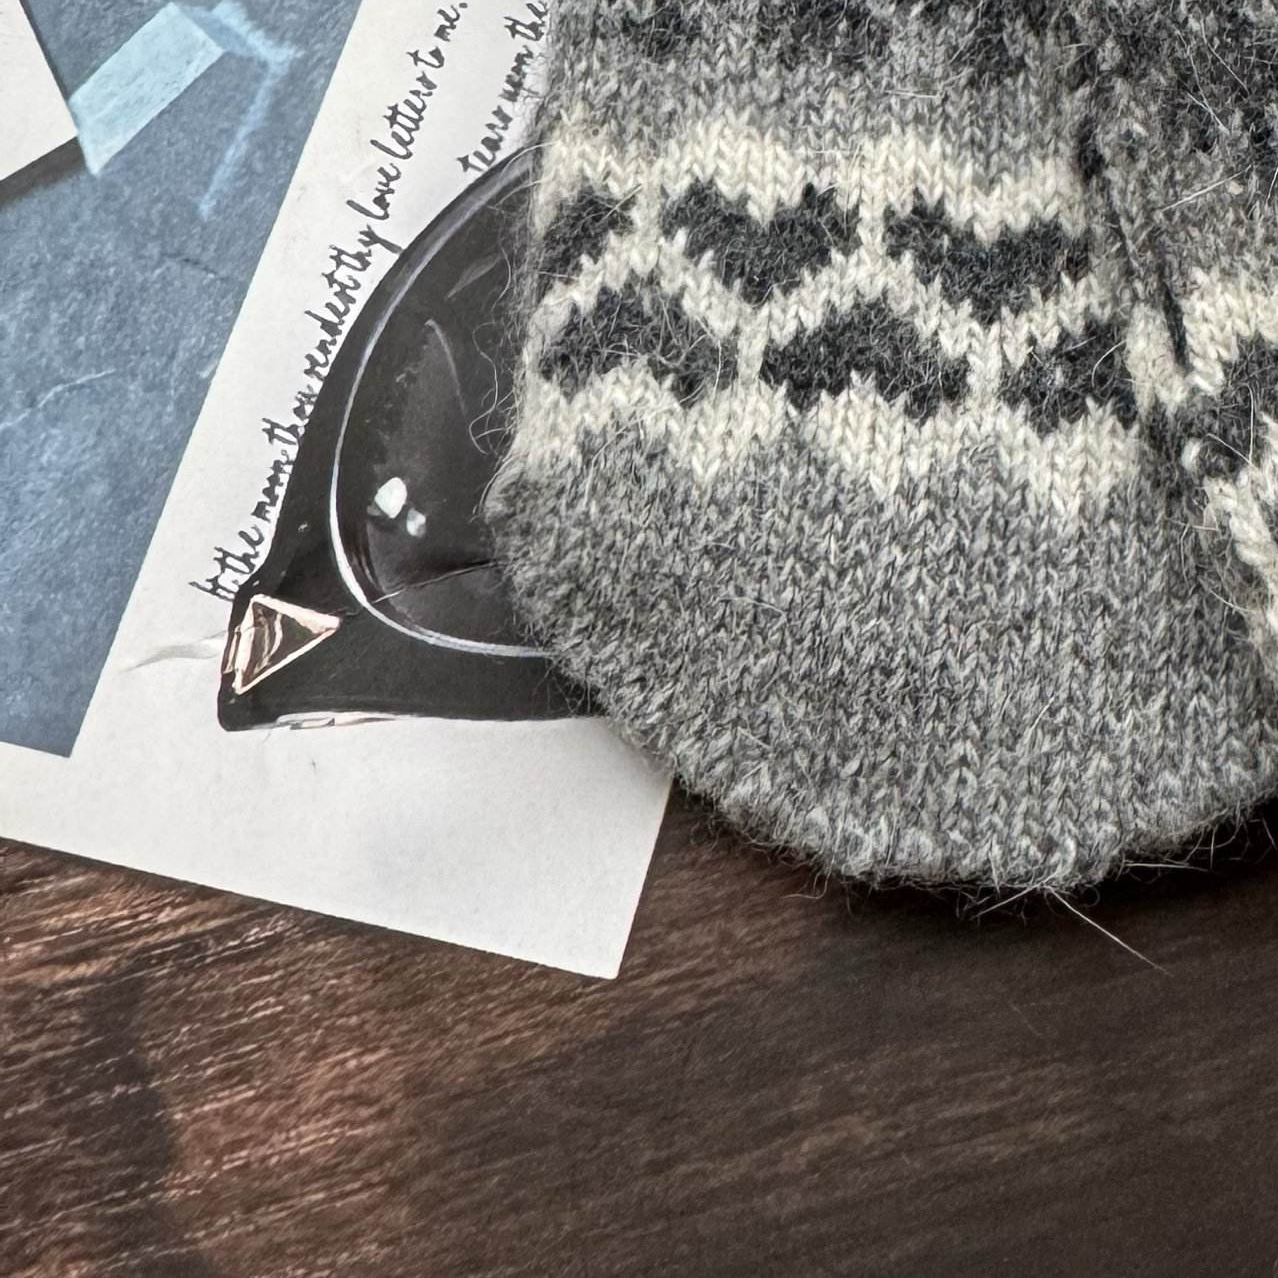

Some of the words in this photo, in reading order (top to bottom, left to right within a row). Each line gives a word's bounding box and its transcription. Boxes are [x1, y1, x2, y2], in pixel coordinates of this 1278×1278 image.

[433, 1, 469, 43] me.
[405, 46, 446, 69] to
[456, 104, 514, 173] tears
[503, 0, 549, 42] the
[369, 71, 438, 160] letters
[345, 162, 402, 221] love
[328, 224, 403, 272] thy
[213, 524, 265, 575] the
